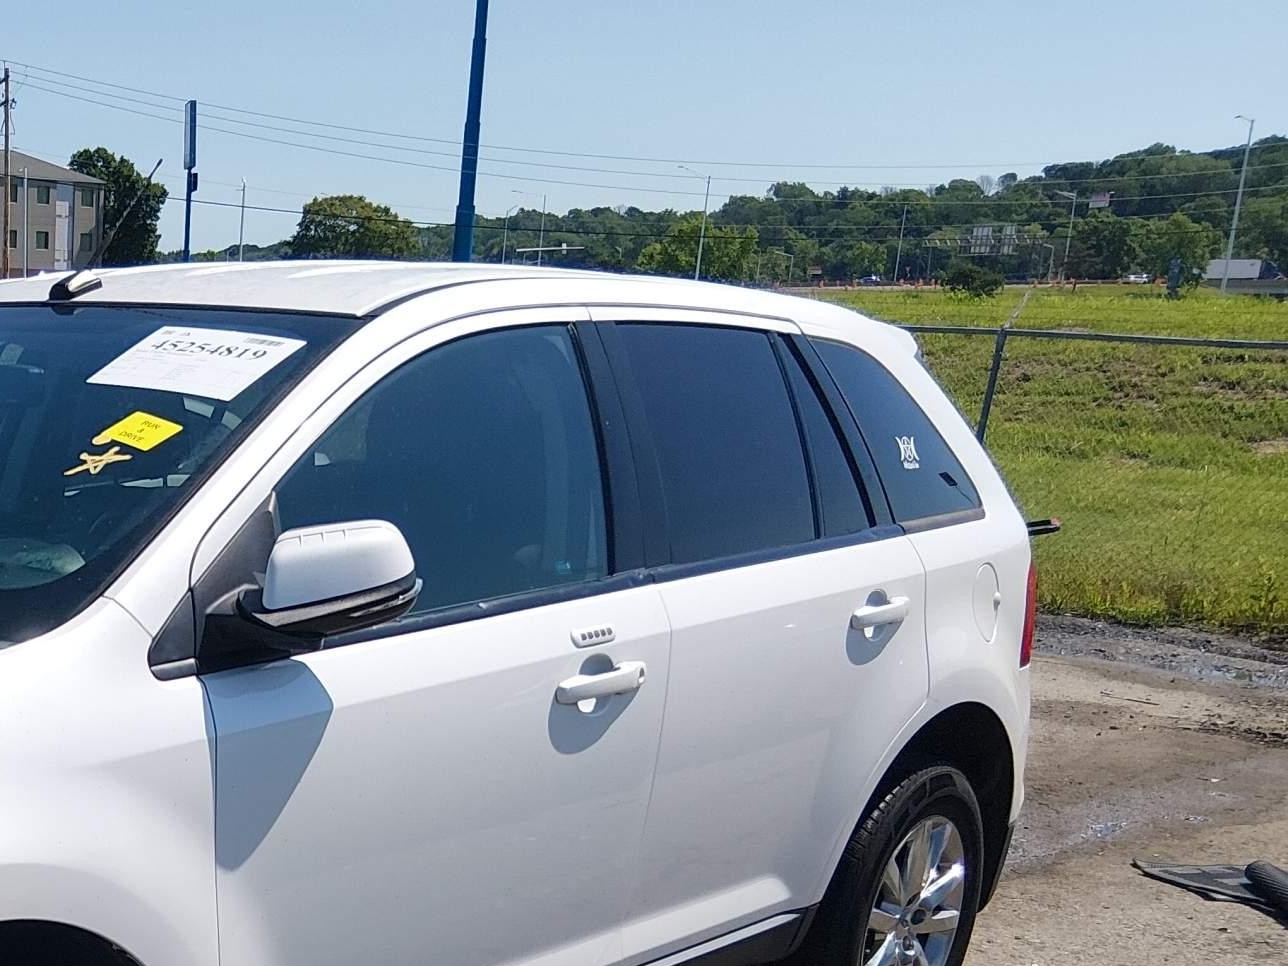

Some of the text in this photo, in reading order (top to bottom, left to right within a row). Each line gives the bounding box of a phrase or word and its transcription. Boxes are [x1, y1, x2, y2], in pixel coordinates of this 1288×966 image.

[151, 339, 268, 360] 45254819
[140, 420, 161, 430] RUN
[118, 430, 145, 442] DRIVE
